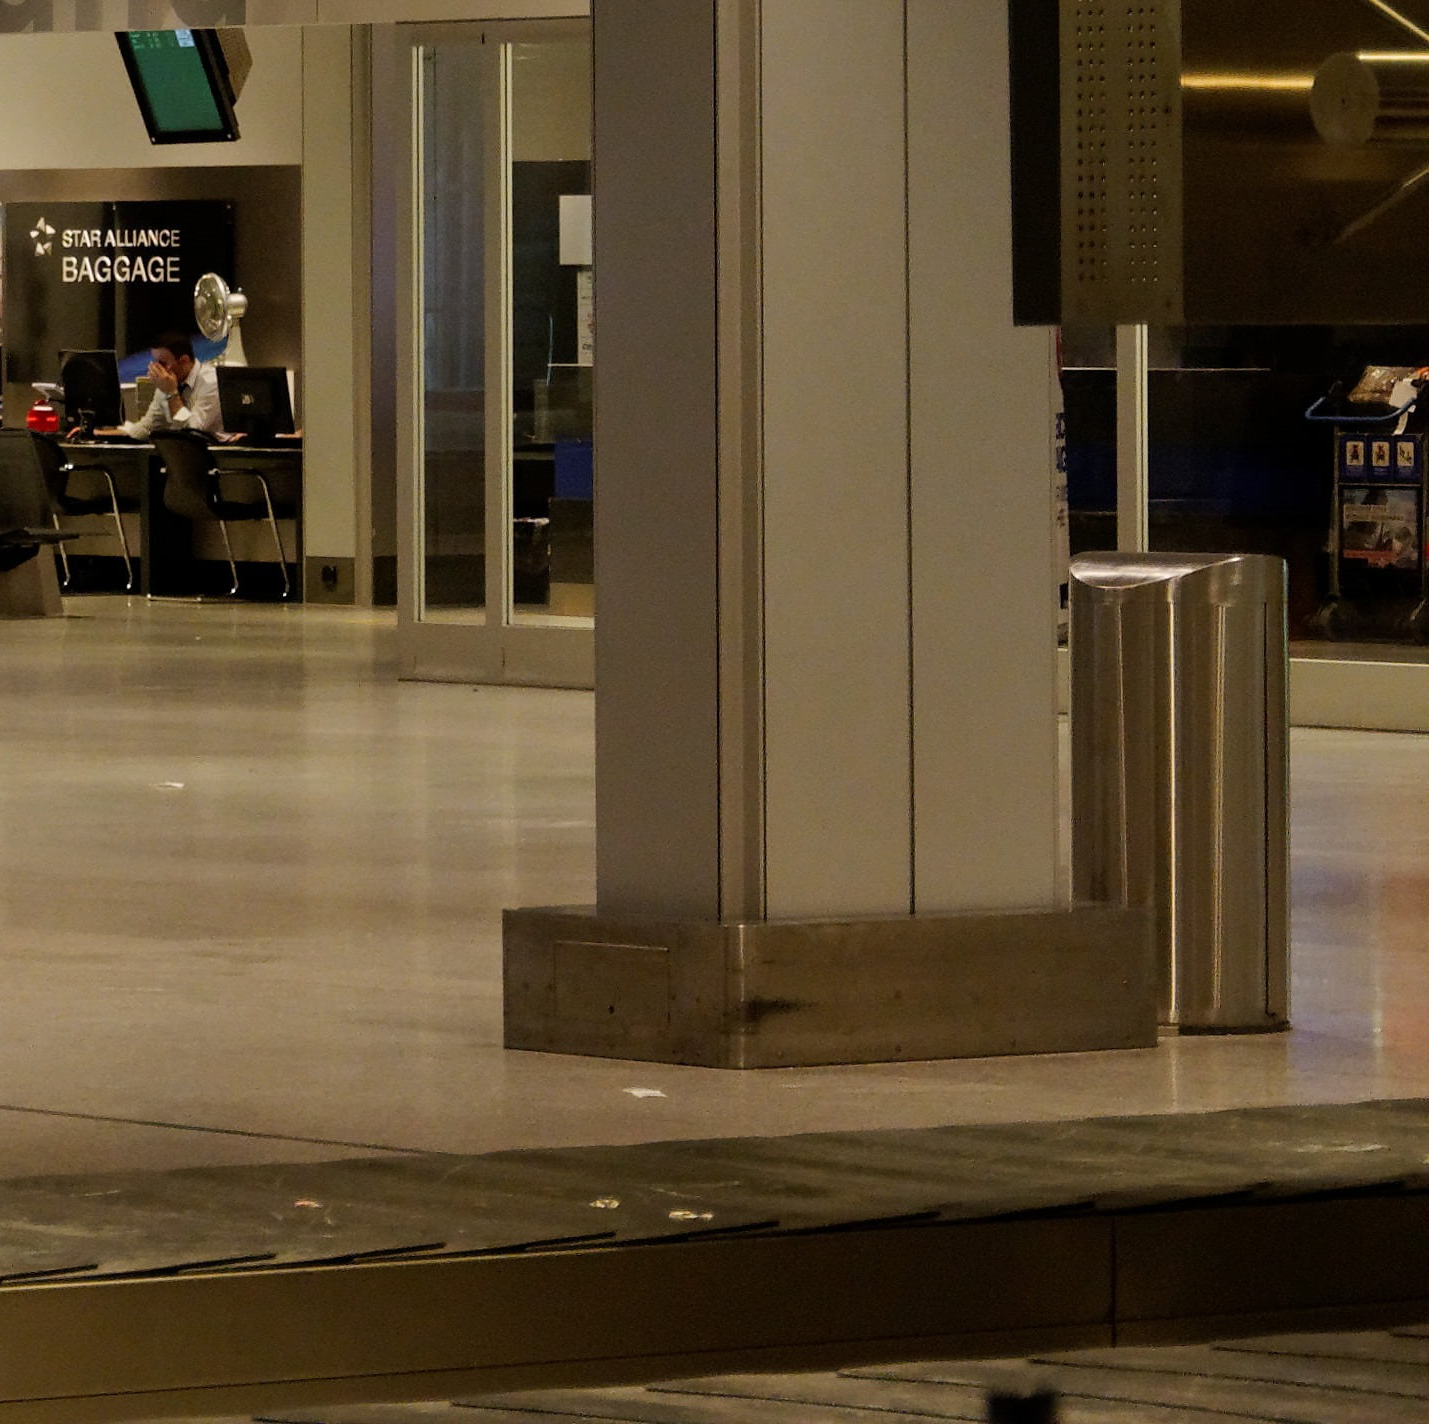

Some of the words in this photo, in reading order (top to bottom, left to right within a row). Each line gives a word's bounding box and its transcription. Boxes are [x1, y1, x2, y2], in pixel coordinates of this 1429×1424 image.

[62, 229, 101, 248] STAR
[104, 229, 181, 248] ALLIANCE
[62, 256, 181, 283] BAGGAGE
